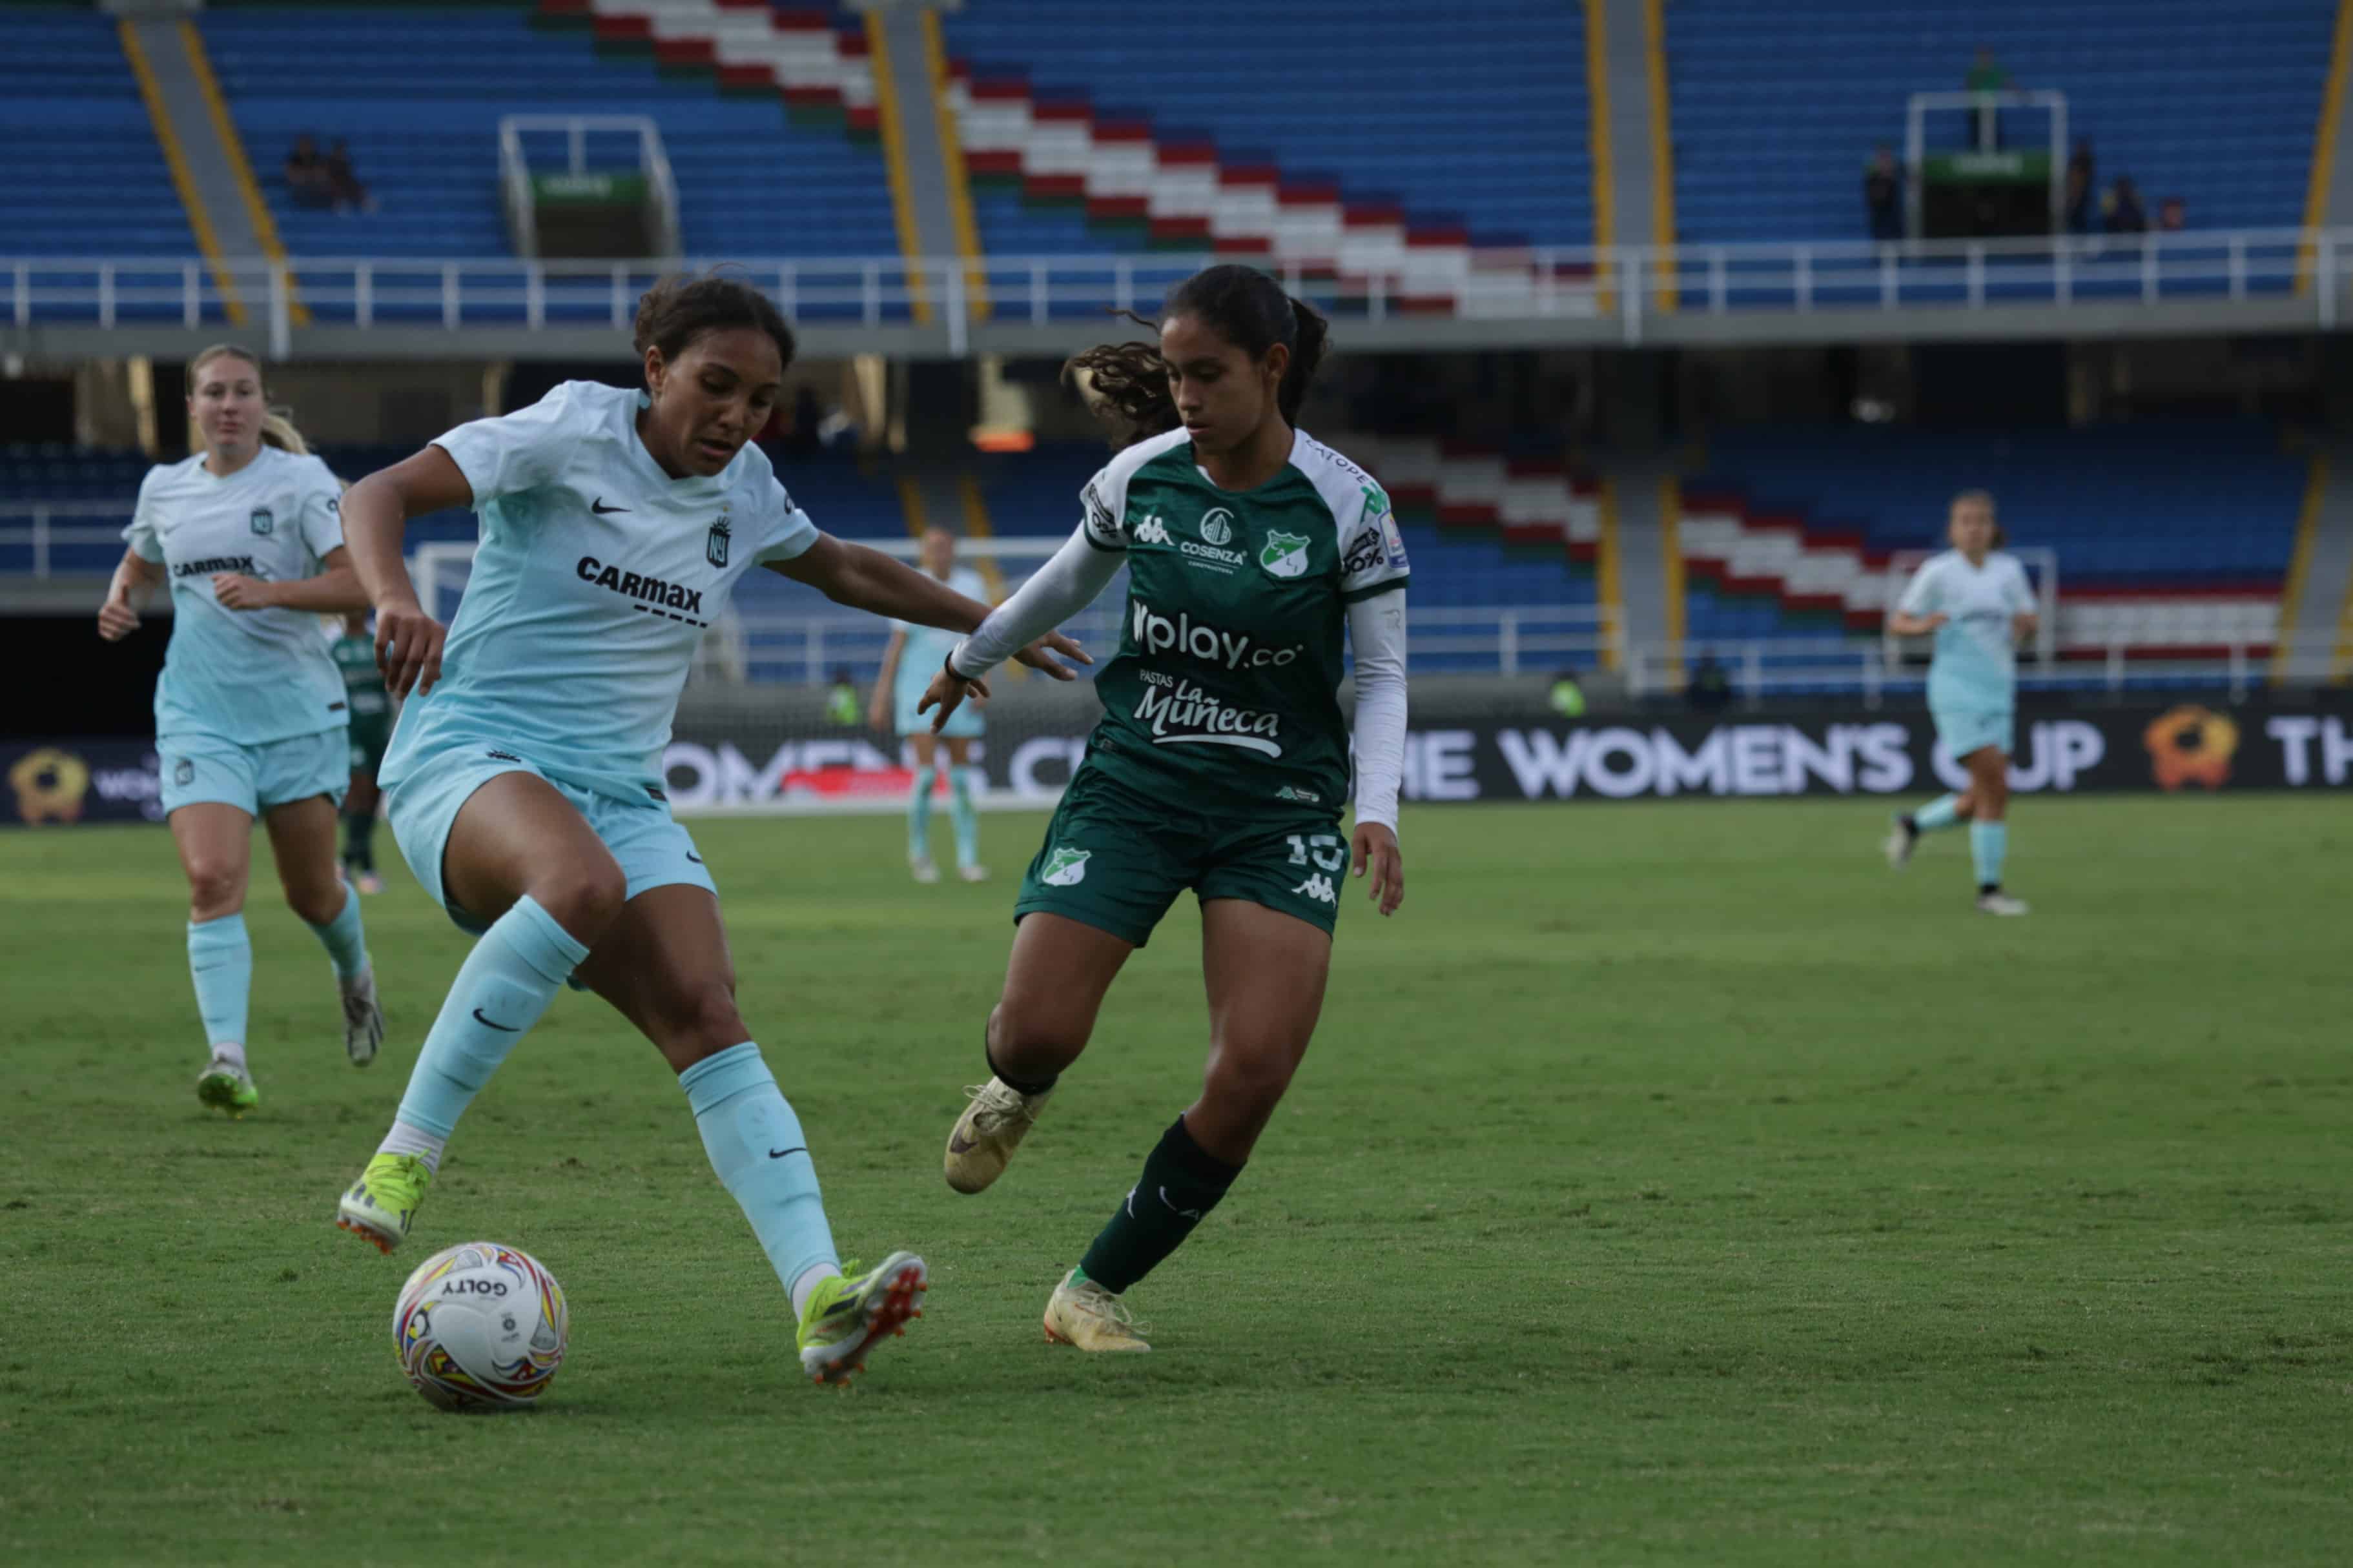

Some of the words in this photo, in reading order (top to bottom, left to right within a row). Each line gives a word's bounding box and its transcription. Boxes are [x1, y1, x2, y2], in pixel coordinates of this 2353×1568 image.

[1180, 542, 1244, 565] COSENZA
[1140, 669, 1173, 688] PASTAS
[1175, 678, 1202, 703] La
[1134, 686, 1280, 736] Muñeca
[1495, 721, 1914, 800] WOMEN'S
[442, 1279, 508, 1296] GOLTY
